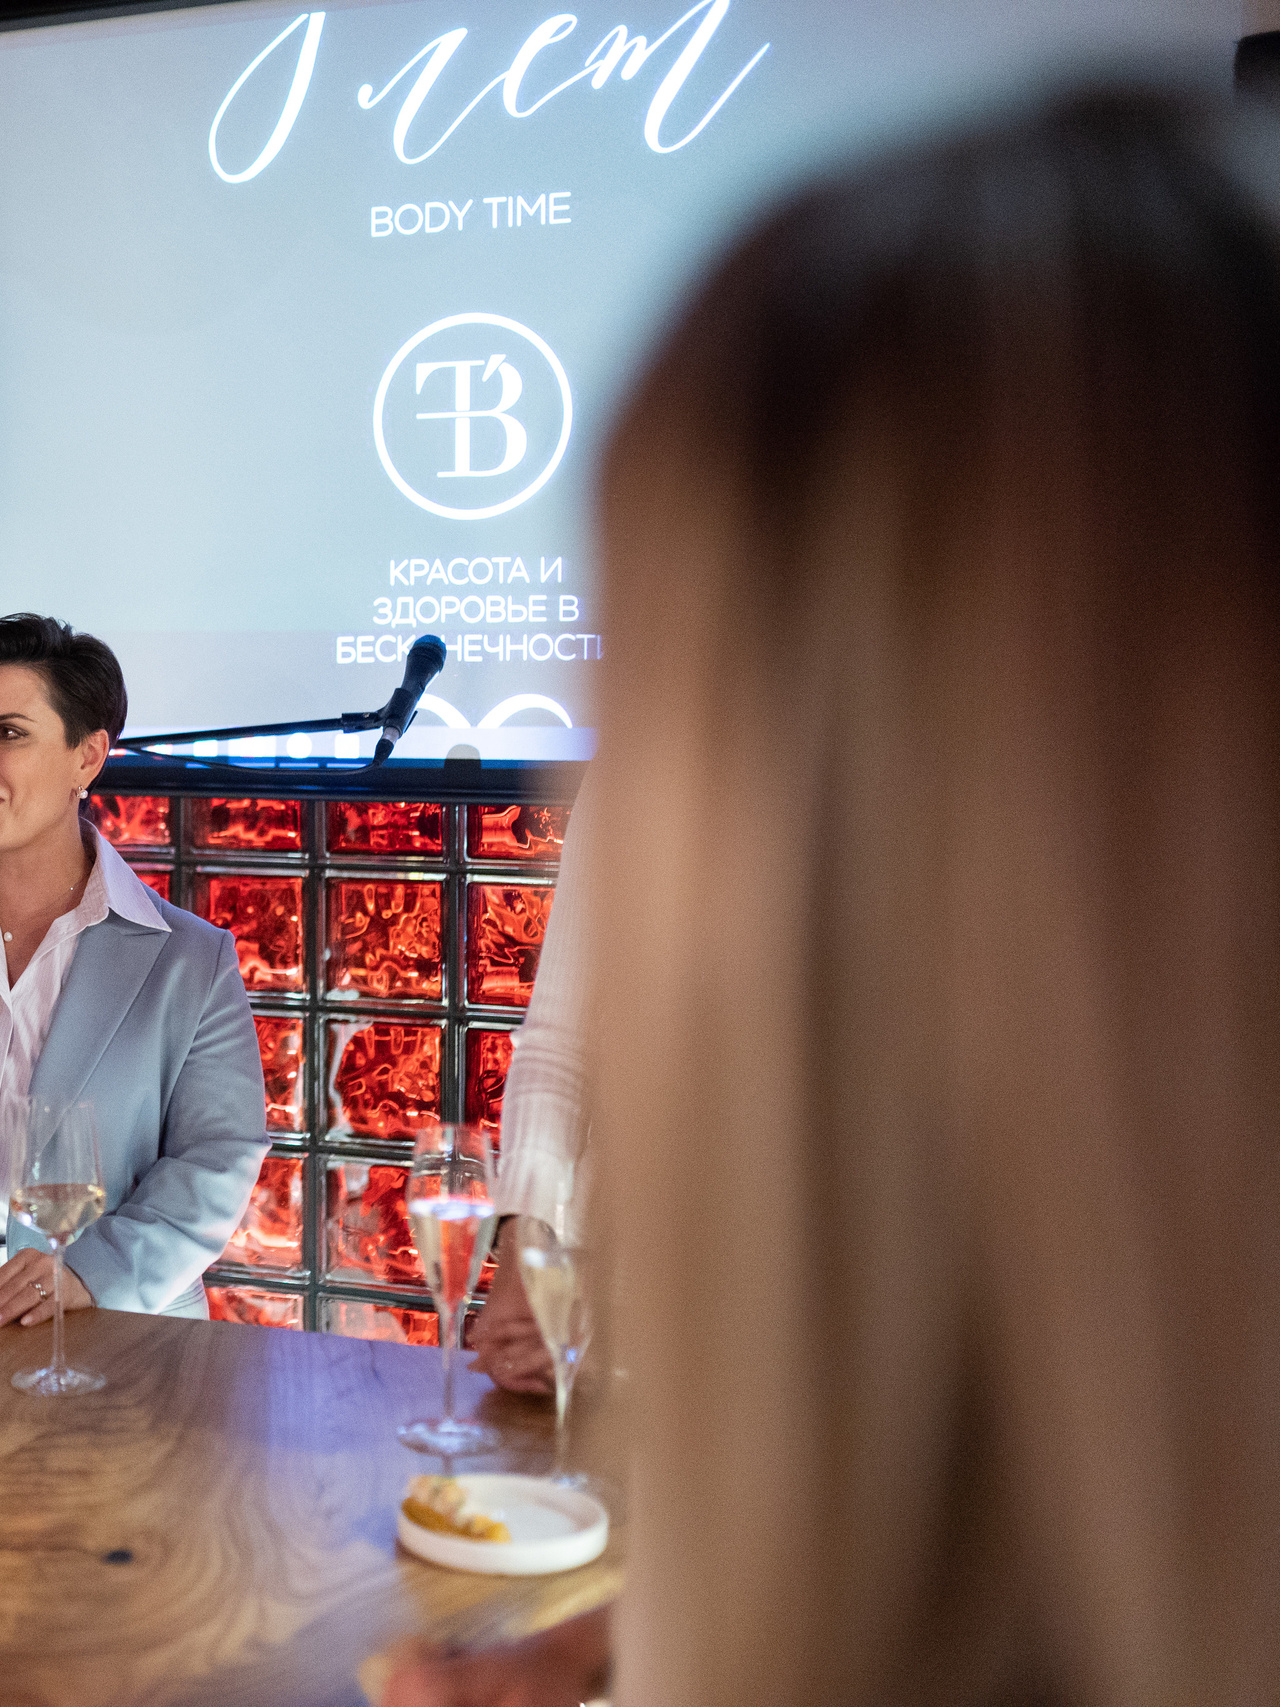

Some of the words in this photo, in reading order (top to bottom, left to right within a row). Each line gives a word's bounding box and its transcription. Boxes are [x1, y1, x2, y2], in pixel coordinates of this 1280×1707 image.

[371, 199, 473, 237] BODY
[483, 192, 572, 229] TIME
[389, 557, 531, 586] КРАСОТА
[540, 556, 563, 583] И
[373, 595, 548, 628] ЗДОРОВЬЕ
[559, 595, 580, 622] В
[336, 632, 603, 664] БЕСКНЕЧНОСТ
